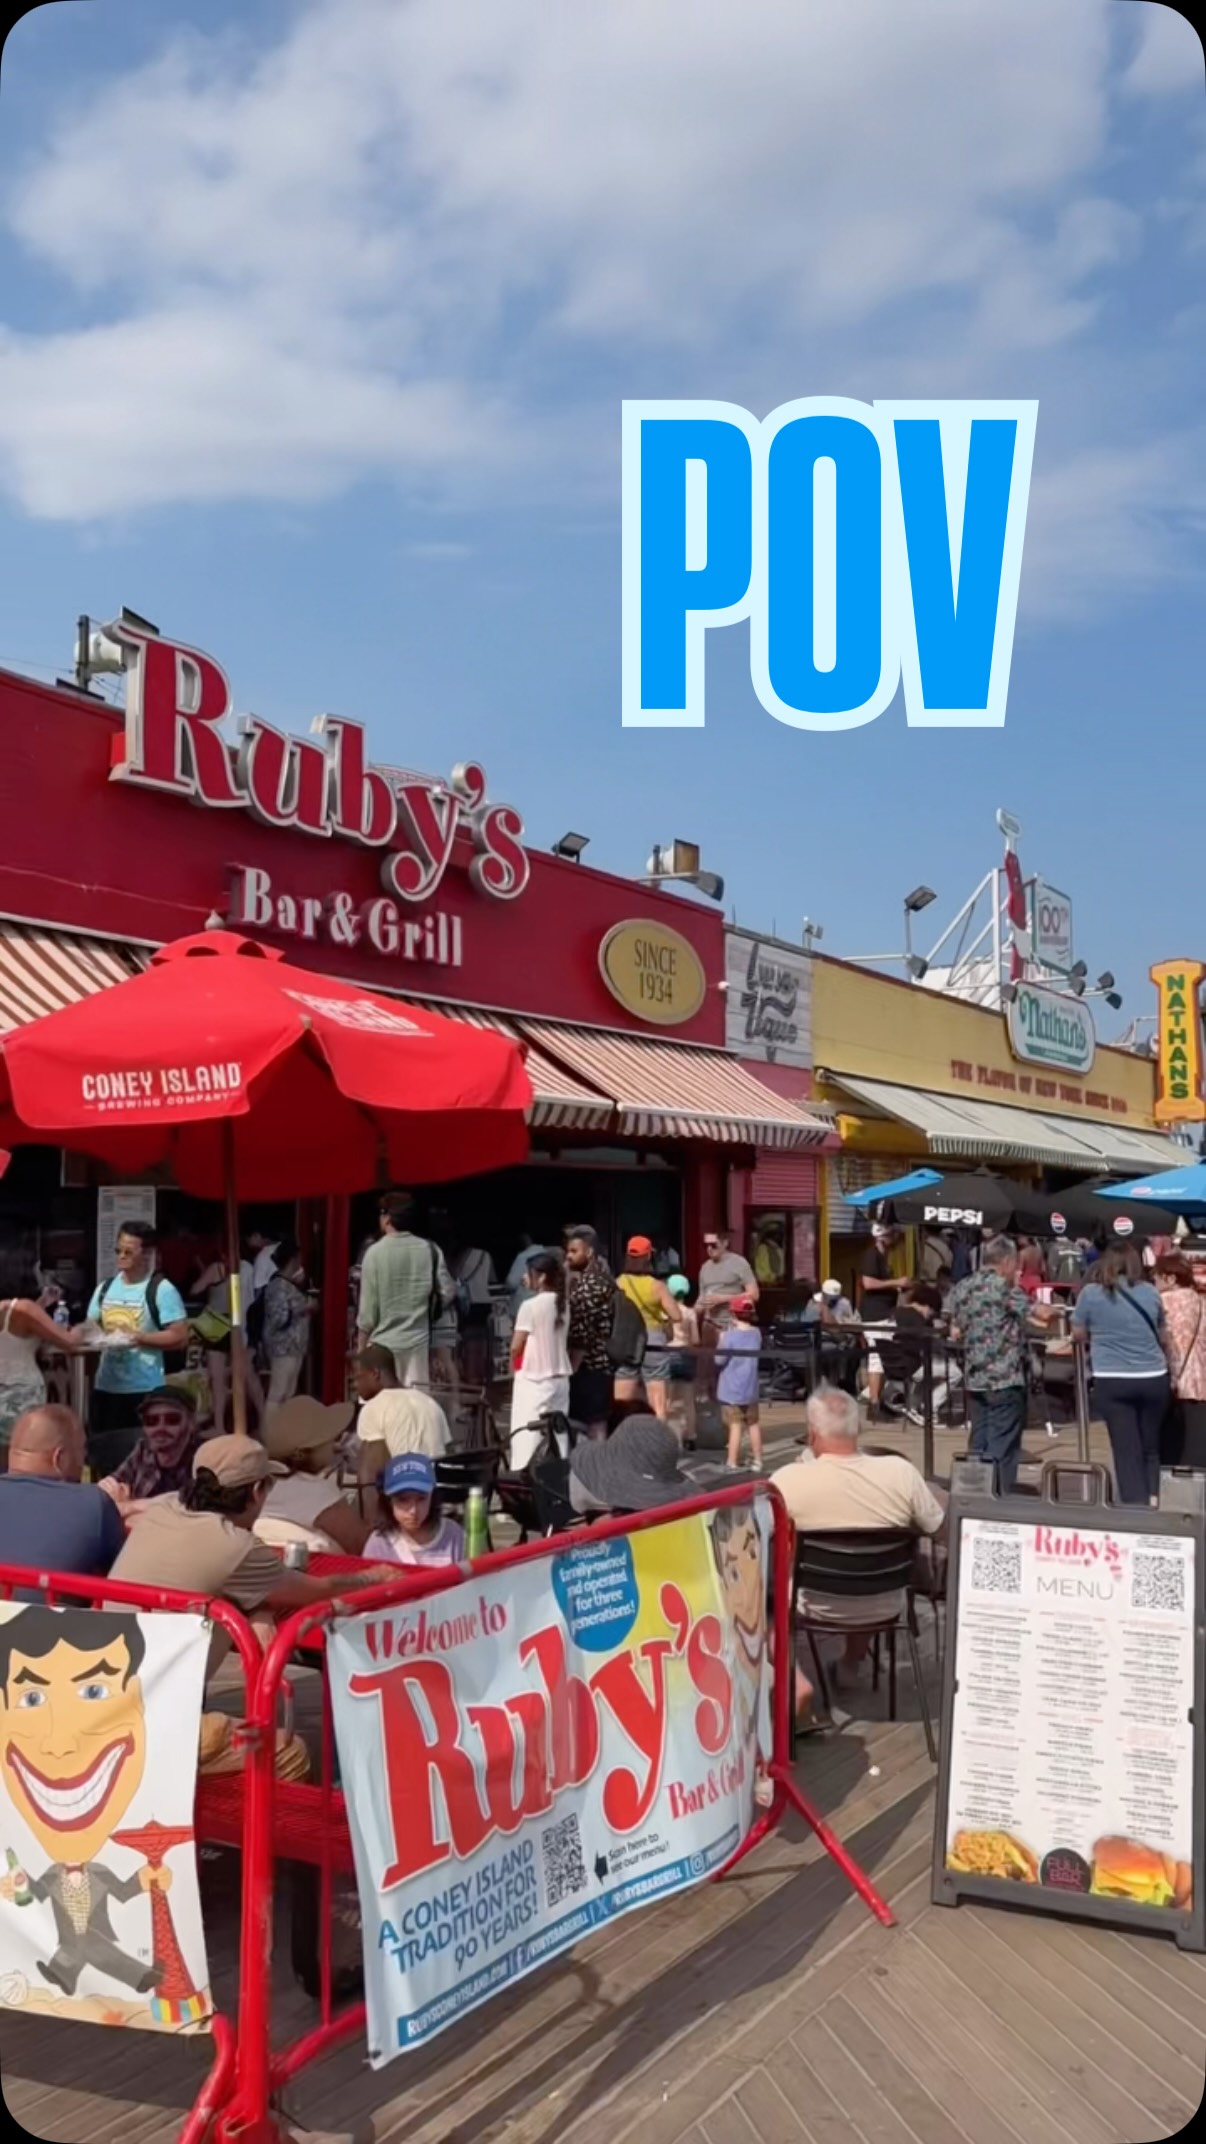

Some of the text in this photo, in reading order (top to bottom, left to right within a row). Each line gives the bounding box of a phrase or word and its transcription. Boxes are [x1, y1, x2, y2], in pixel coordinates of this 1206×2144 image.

[102, 618, 530, 902] Ruby's
[238, 865, 463, 967] Bar & Grill
[633, 938, 677, 976] SINCE
[638, 972, 673, 1005] 1934
[1019, 990, 1087, 1052] Nathan's
[1166, 974, 1190, 1100] NATHANS
[82, 1062, 241, 1101] CONEY ISLAND
[951, 1060, 973, 1082] THE
[97, 1092, 230, 1112] BREWING COMPANY
[923, 1205, 983, 1225] PEPSI
[1034, 1524, 1120, 1567] Ruby's
[575, 1589, 624, 1613] for three
[584, 1569, 628, 1595] operated
[1036, 1575, 1115, 1601] MENU
[365, 1596, 507, 1661] Welcome to
[348, 1581, 733, 1893] Ruby's
[665, 1780, 705, 1821] Bar
[648, 1833, 659, 1843] to
[378, 1919, 400, 1949] A
[402, 1875, 471, 1935] CONEY
[476, 1839, 535, 1897] ISLAND
[391, 1890, 505, 1974] TRADITION
[506, 1865, 537, 1907] FOR
[454, 1892, 540, 1972] 90 YEARS!
